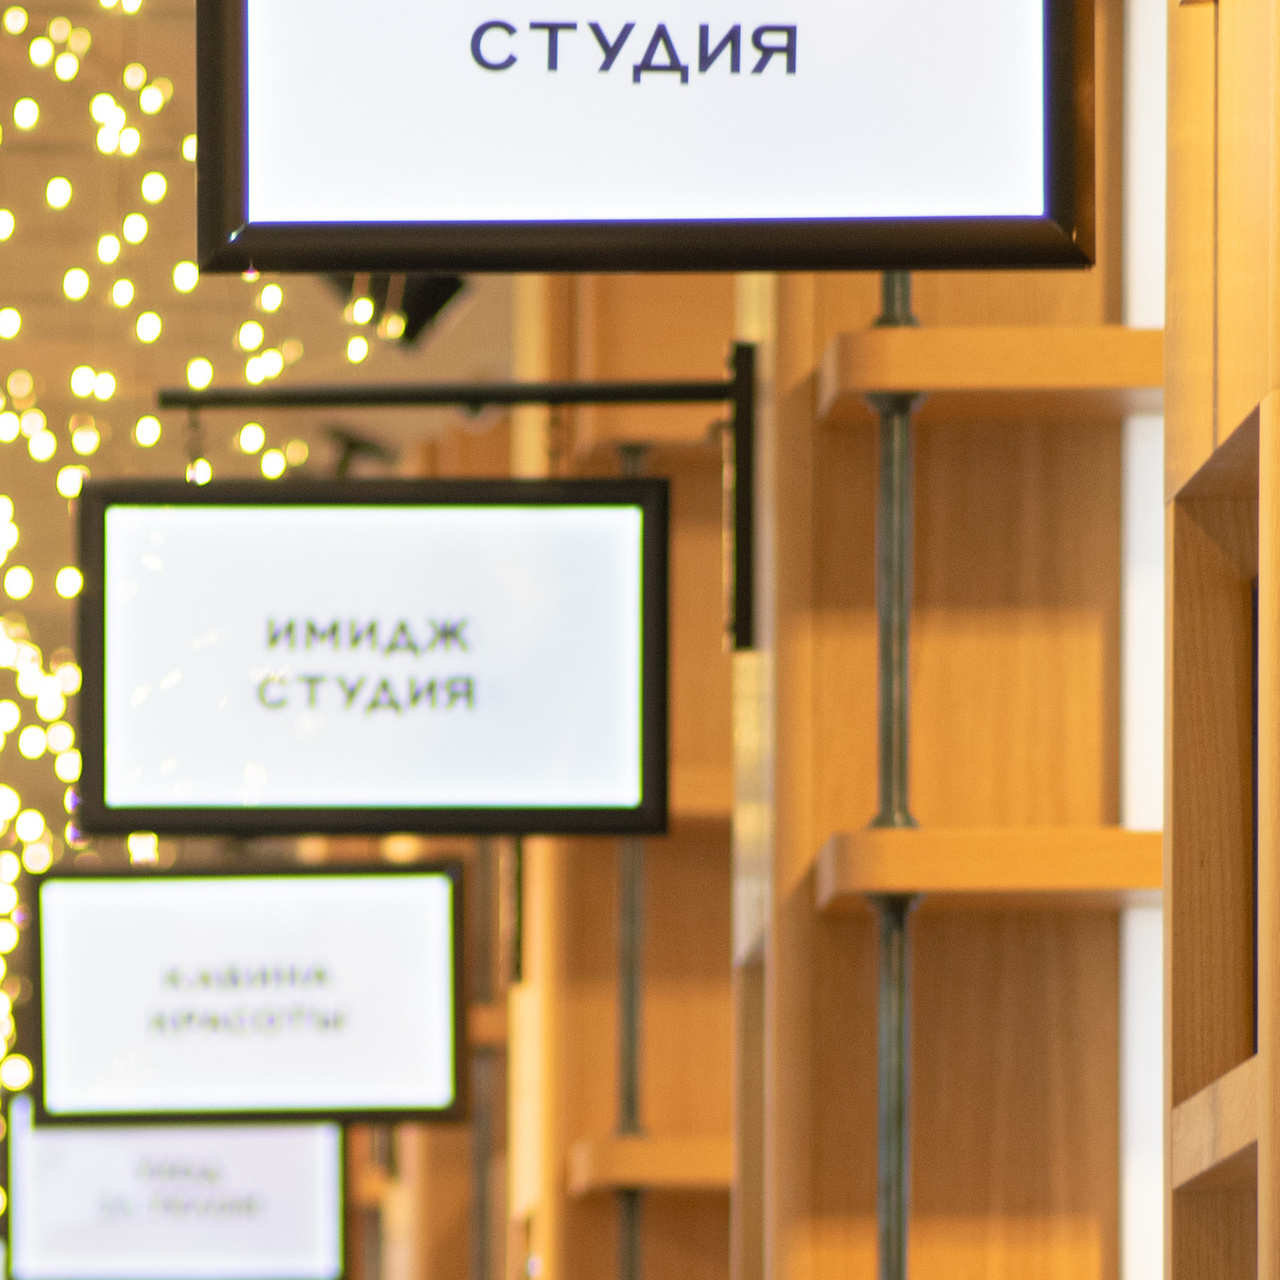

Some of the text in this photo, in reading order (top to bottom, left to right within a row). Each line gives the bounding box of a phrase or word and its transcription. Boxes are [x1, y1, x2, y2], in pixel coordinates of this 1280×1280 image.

[469, 18, 799, 85] СТУДИЯ
[264, 617, 471, 658] ИМИДЖ
[254, 671, 479, 716] СТУДИЯ
